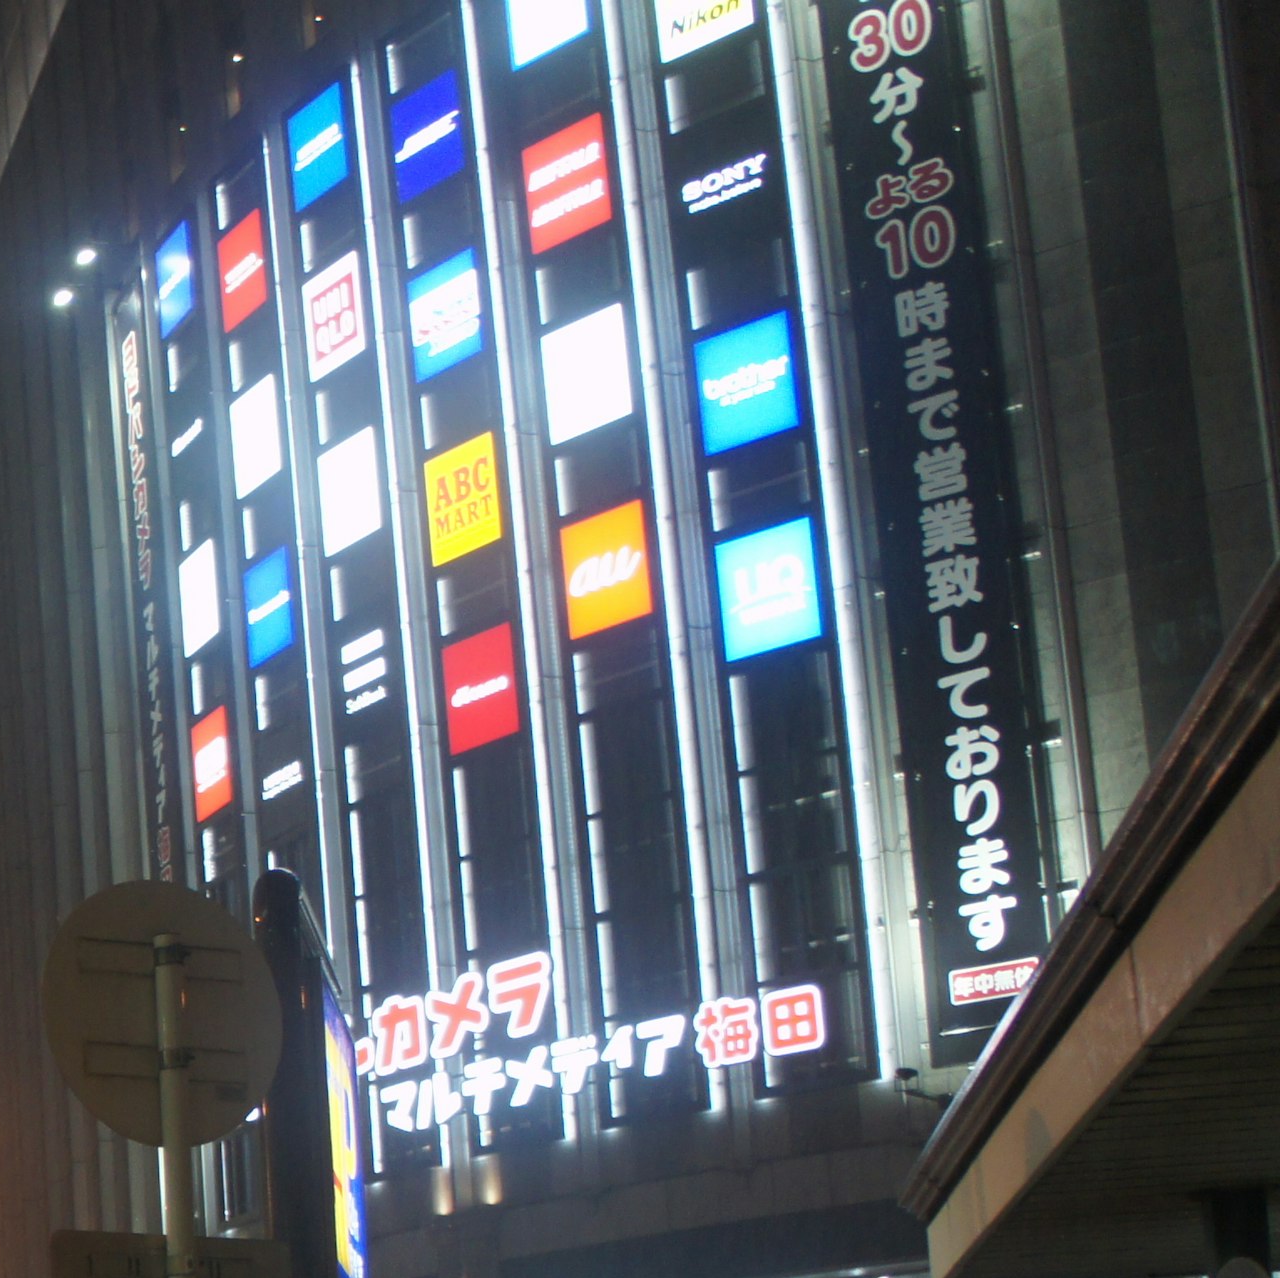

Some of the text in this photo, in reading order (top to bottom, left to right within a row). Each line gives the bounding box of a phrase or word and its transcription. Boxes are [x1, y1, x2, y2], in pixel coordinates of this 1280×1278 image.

[670, 0, 740, 38] Nikon
[682, 152, 767, 203] SONY
[312, 282, 350, 324] UNI
[314, 310, 358, 355] QLO
[703, 355, 789, 402] brother
[434, 459, 490, 511] ABC
[435, 494, 493, 539] MART
[569, 545, 641, 599] au
[356, 951, 553, 1077] カメラ
[380, 983, 827, 1132] マルチメディア 梅田
